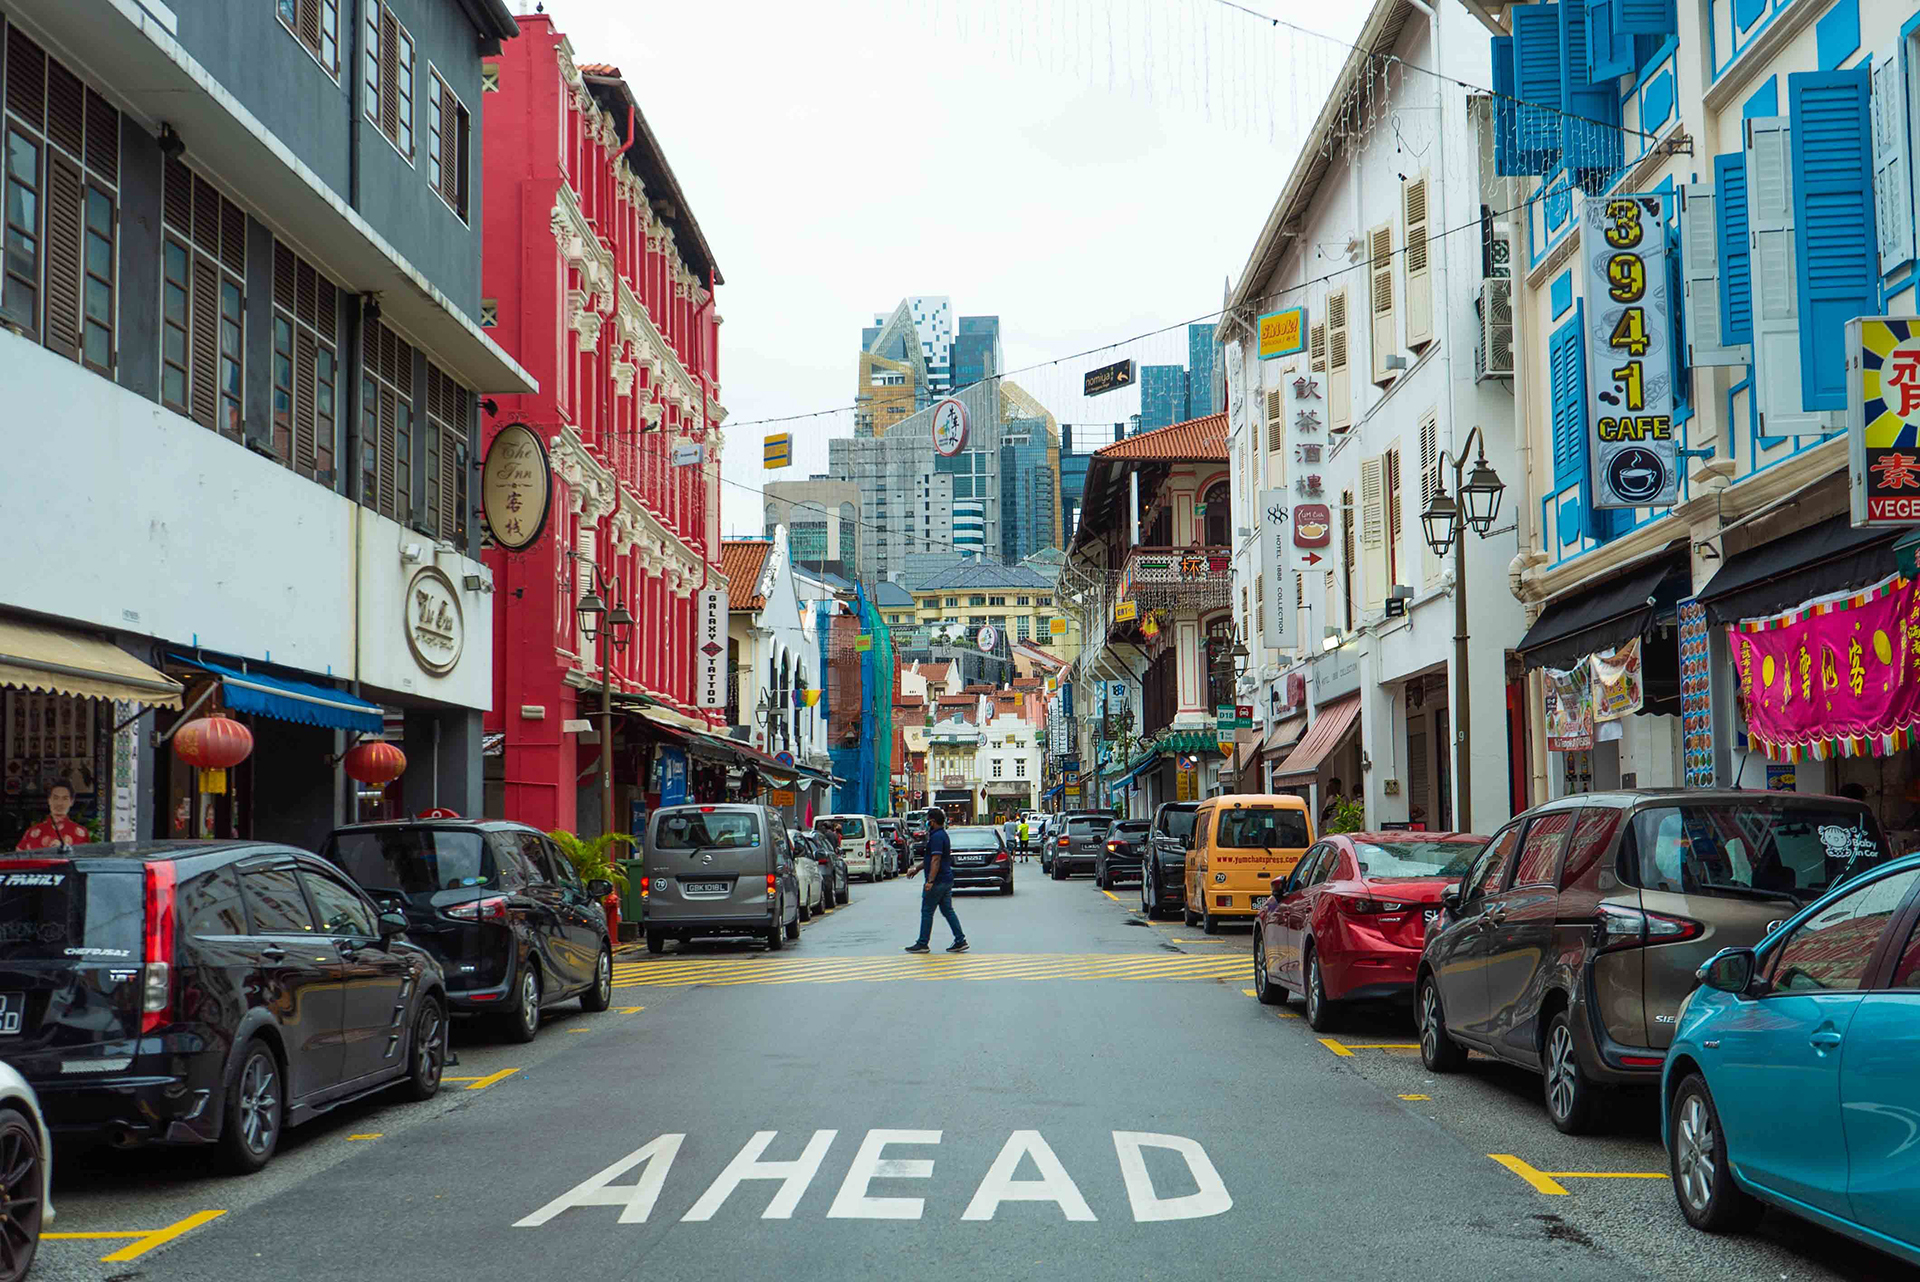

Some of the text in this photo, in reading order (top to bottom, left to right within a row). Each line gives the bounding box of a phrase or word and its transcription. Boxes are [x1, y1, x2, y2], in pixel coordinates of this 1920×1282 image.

[1605, 199, 1649, 411] 3941
[1598, 416, 1671, 442] CAFE
[499, 442, 533, 460] The
[496, 462, 533, 480] Inn
[707, 595, 717, 641] GALAXY
[707, 659, 716, 704] TATTOO
[1219, 731, 1224, 740] 1
[1458, 730, 1465, 742] 9
[604, 771, 611, 788] 10
[1852, 838, 1877, 850] Baby
[1864, 850, 1878, 858] Car
[656, 879, 665, 888] 70
[1655, 1014, 1677, 1024] SIE
[512, 1129, 1234, 1227] AHEAD
